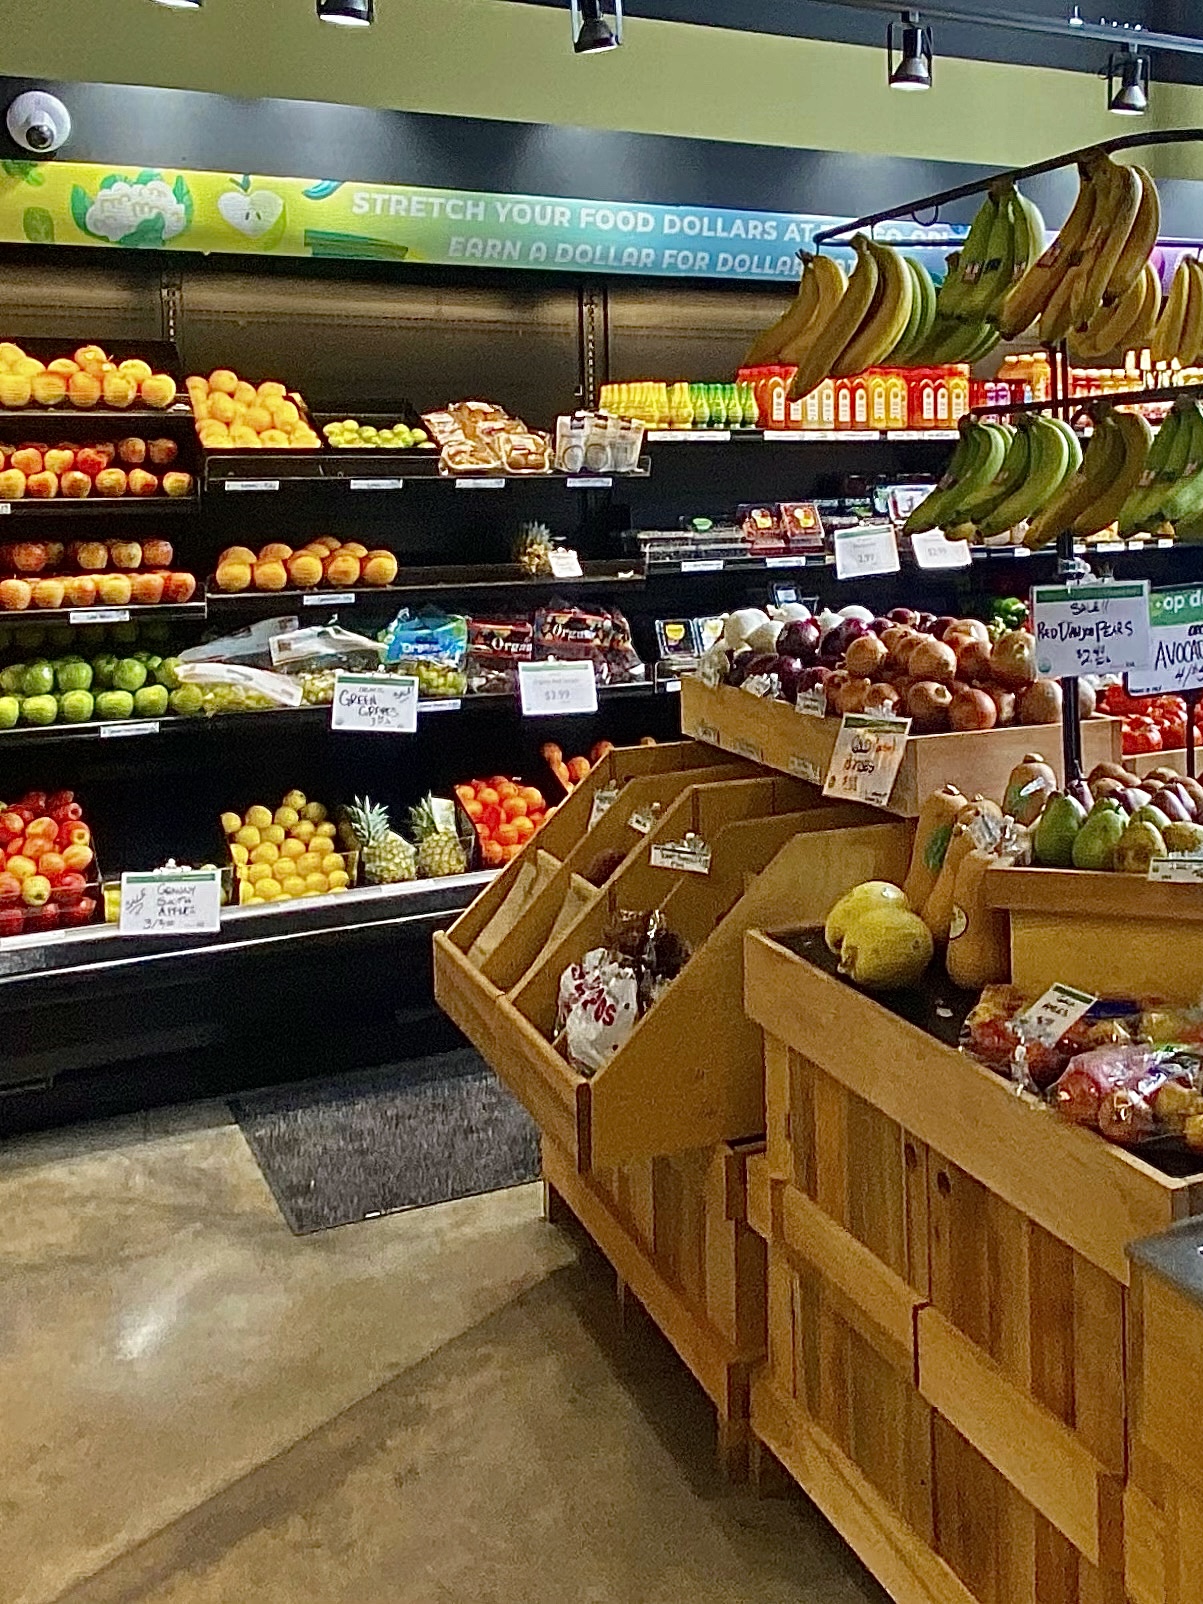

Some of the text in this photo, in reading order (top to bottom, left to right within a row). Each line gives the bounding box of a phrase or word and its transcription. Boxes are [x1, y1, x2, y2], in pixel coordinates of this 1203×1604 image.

[352, 191, 485, 221] STRETCH
[495, 202, 572, 227] YOUR
[579, 207, 655, 233] FOOD
[663, 214, 778, 241] DOLLARS
[783, 222, 813, 243] AT
[449, 236, 804, 276] EARN A DOLLAR FOR DOLLAR
